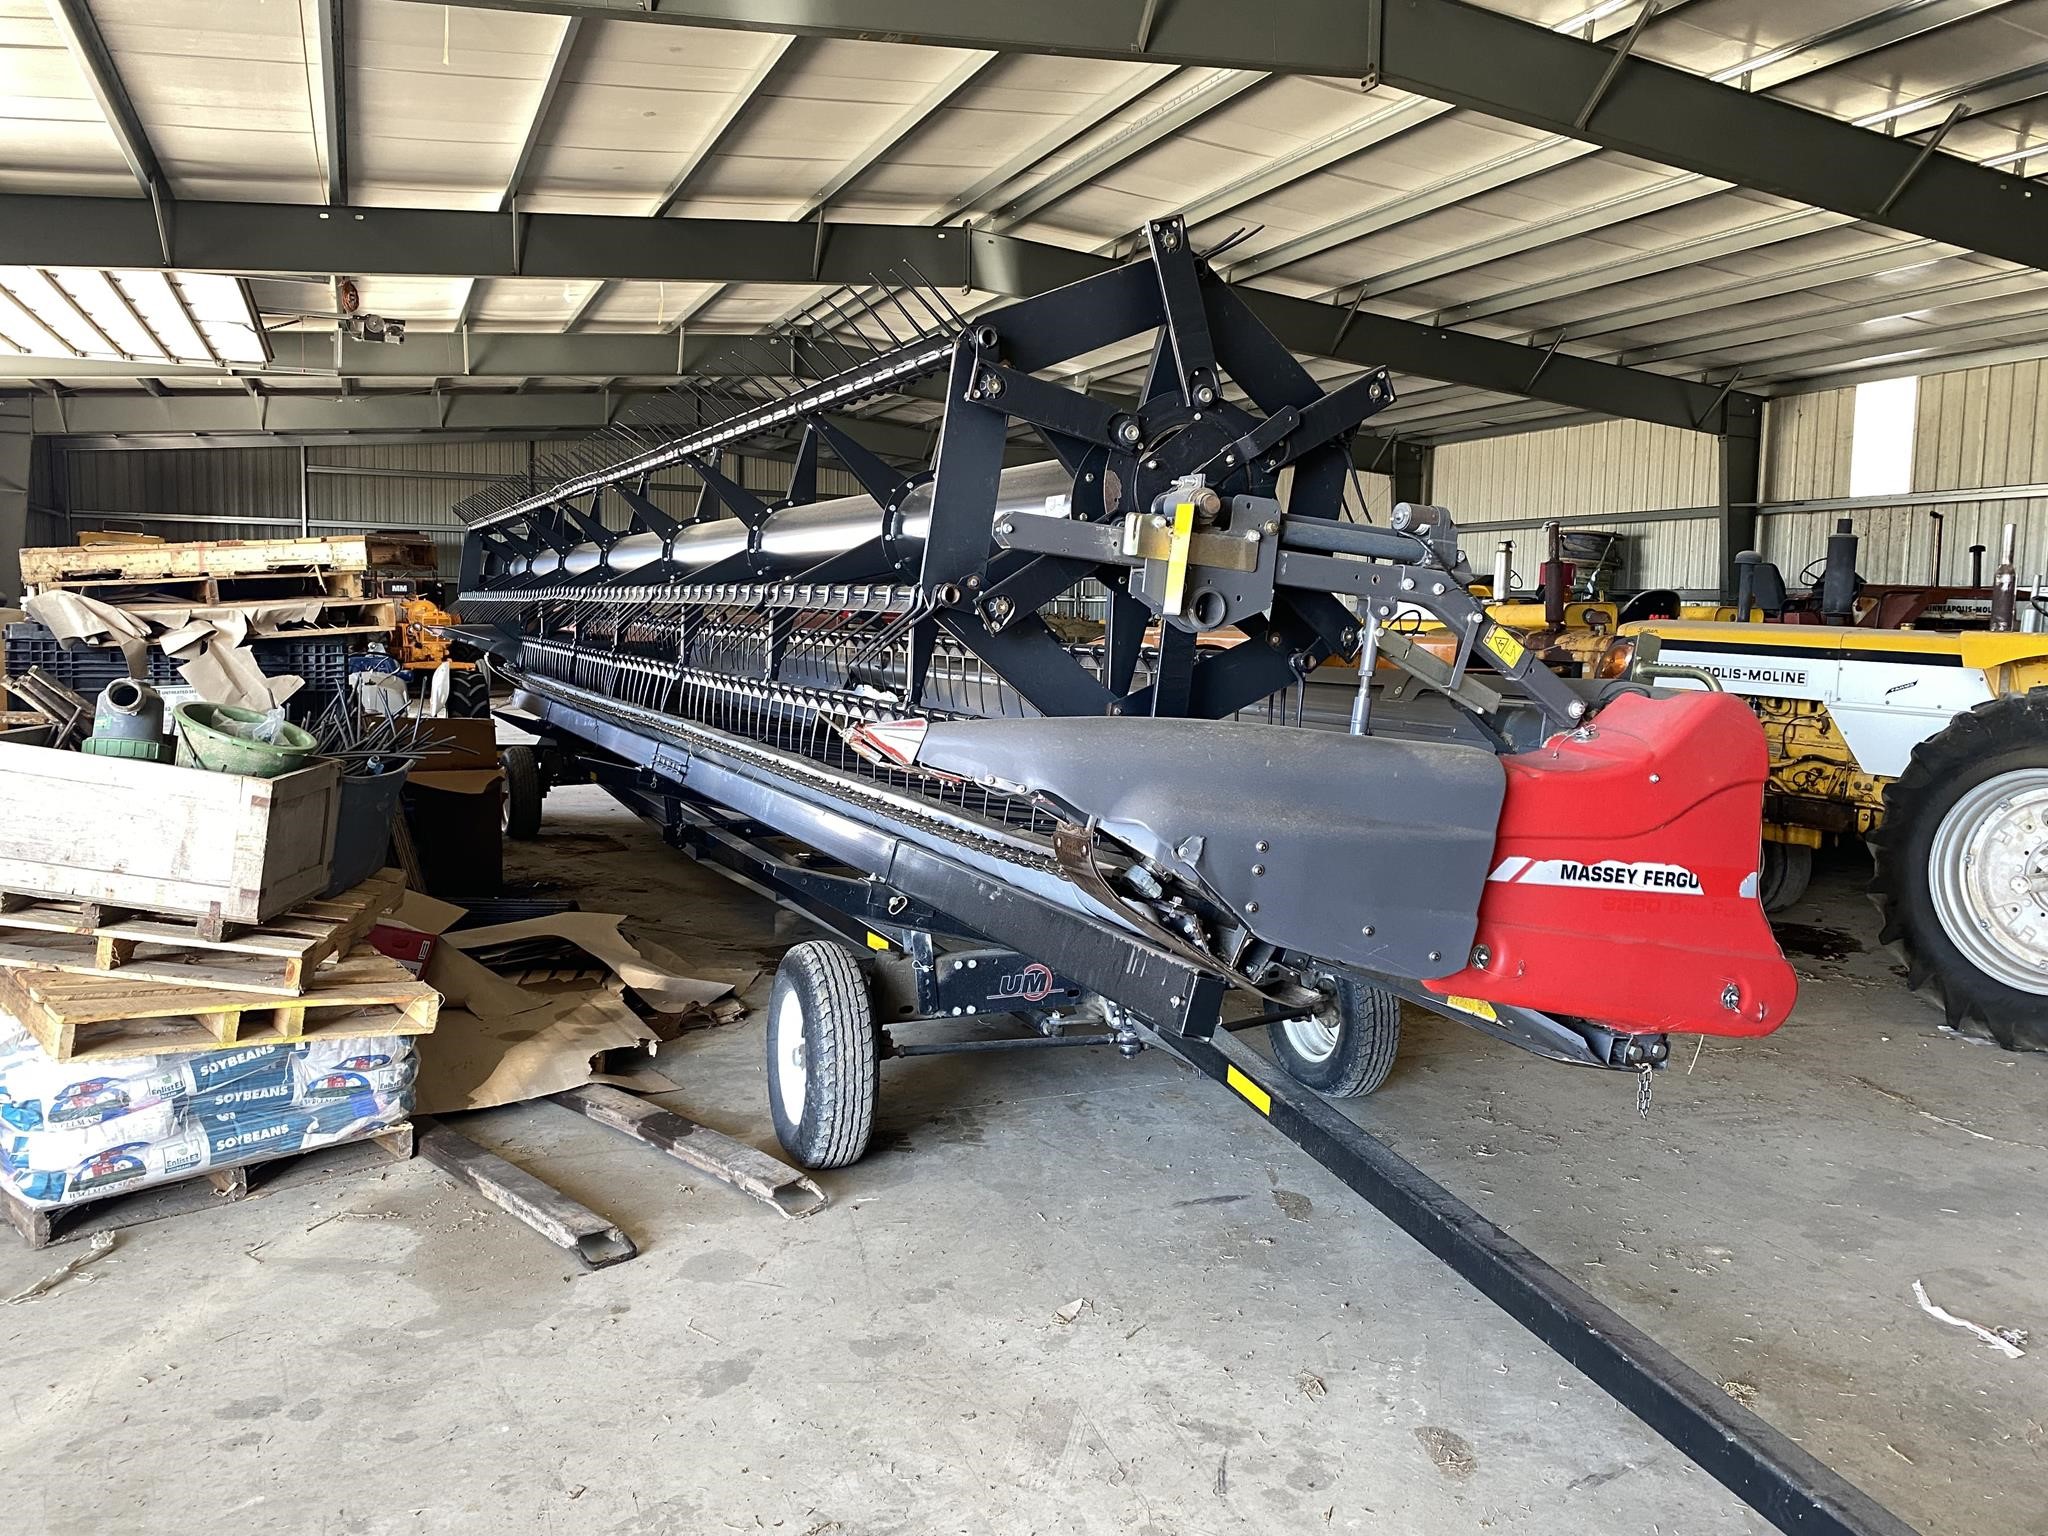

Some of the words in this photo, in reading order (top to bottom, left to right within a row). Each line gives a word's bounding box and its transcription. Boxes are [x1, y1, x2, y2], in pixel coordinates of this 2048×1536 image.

[391, 584, 408, 602] MM
[1560, 864, 1638, 884] MASSEY
[999, 971, 1046, 996] UM
[200, 1044, 275, 1077] SOYBEANS
[151, 1084, 174, 1096] Enlist
[214, 1085, 289, 1105] SOYBEANS
[216, 1124, 290, 1151] SOYBEANS
[166, 1156, 189, 1168] Enlist
[189, 1153, 199, 1161] E3
